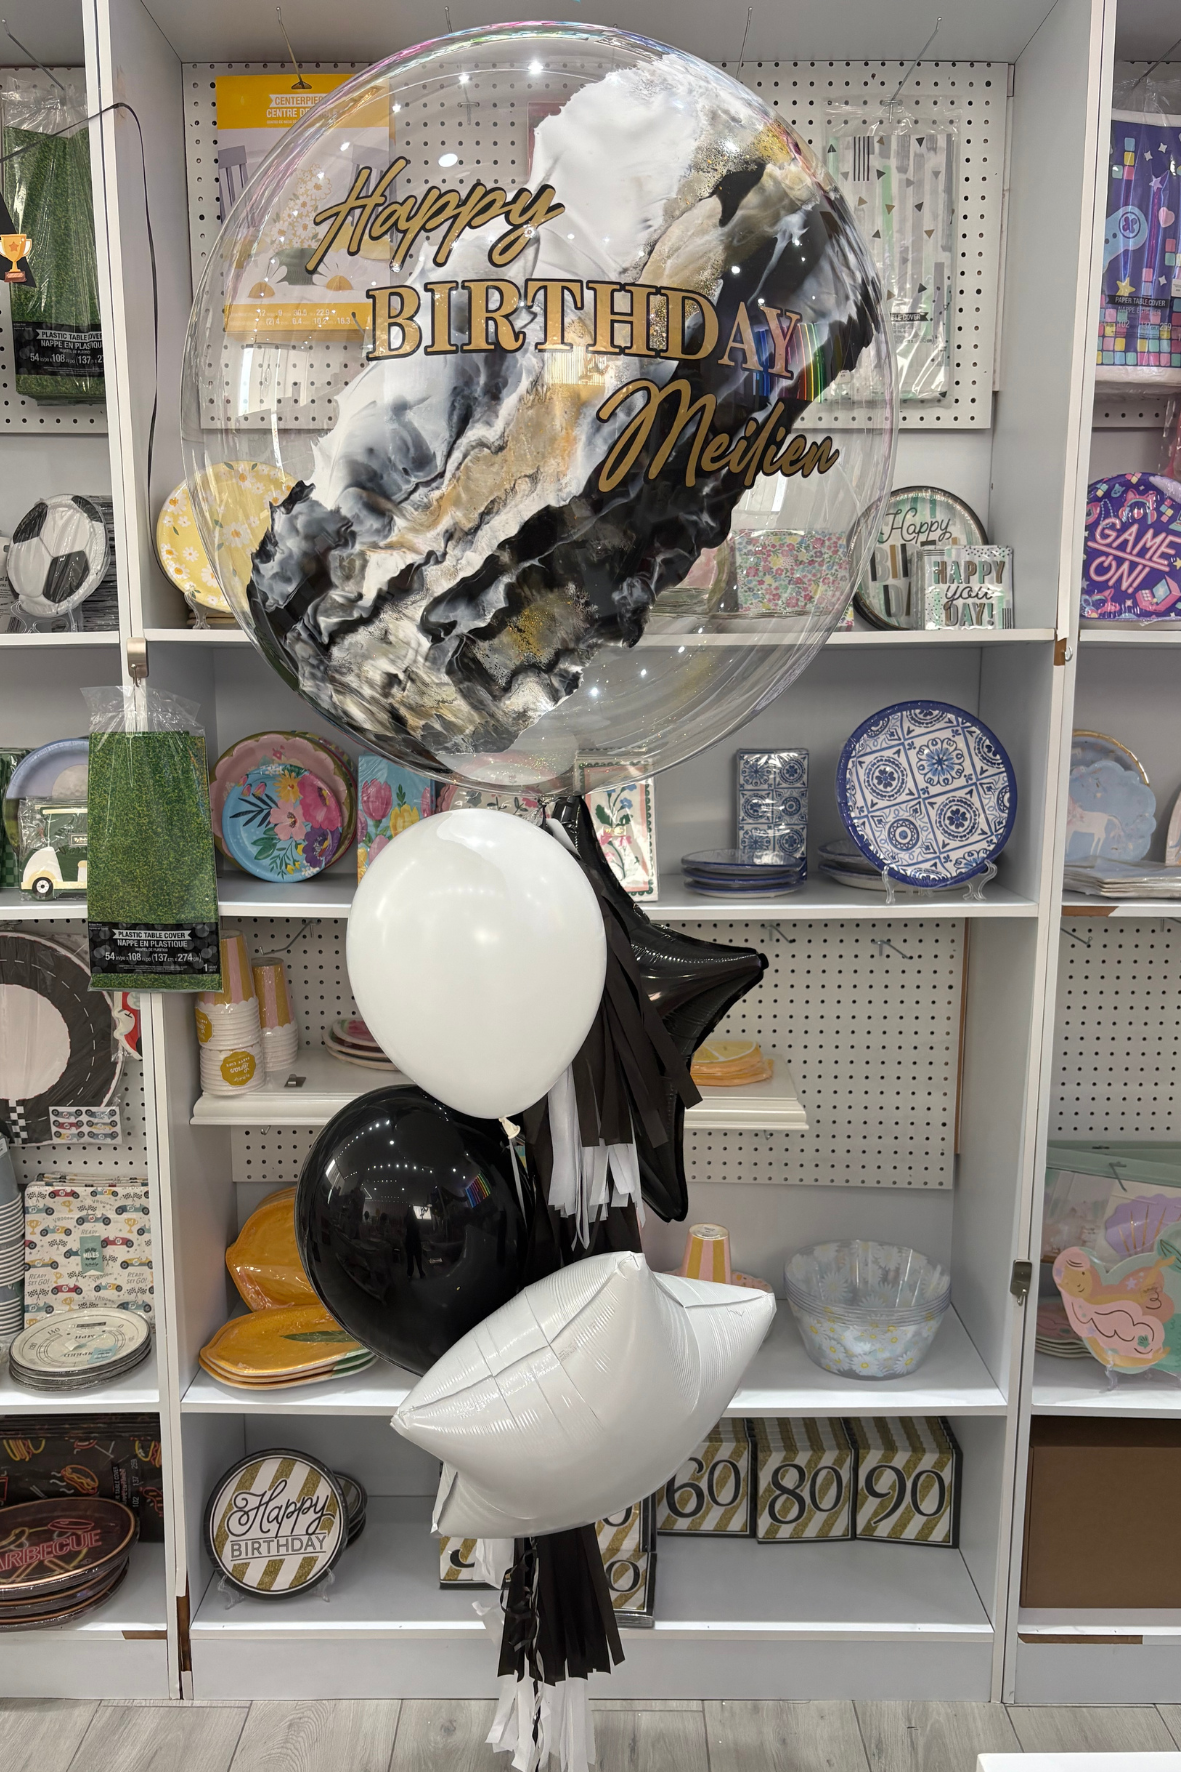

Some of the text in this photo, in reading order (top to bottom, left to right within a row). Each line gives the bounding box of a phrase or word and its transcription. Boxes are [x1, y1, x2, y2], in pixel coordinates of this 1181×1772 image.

[266, 108, 298, 118] CENTRE
[274, 96, 323, 105] CENTERPIE
[305, 156, 566, 274] Happy
[1115, 296, 1131, 304] PAPER
[1148, 299, 1166, 307] COVER
[41, 331, 67, 340] PLASTIC
[69, 333, 88, 341] TABLE
[365, 278, 803, 379] BIRTHDAY
[41, 339, 63, 348] NAPPE
[64, 341, 74, 349] EN
[30, 352, 40, 361] 54
[52, 353, 66, 362] 108
[596, 378, 840, 492] Meilien
[877, 507, 953, 545] Happy
[1094, 517, 1181, 566] GAME
[932, 560, 1006, 585] HAPPY
[1089, 555, 1150, 594] ON!
[944, 585, 993, 610] you
[944, 602, 995, 627] DAY!
[117, 939, 138, 947] NAPPE
[150, 940, 188, 948] PLASTIQUE
[143, 931, 163, 939] TABLE
[164, 931, 186, 939] COVER
[105, 952, 115, 961] 54
[128, 952, 141, 961] 108
[136, 1277, 148, 1285] GO!
[665, 1457, 741, 1518] 60
[768, 1463, 844, 1525] 80
[864, 1464, 946, 1526] 90
[226, 1479, 336, 1539] Happy
[0, 1529, 102, 1572] RBECUE
[230, 1535, 327, 1559] BIRTHDAY
[605, 1559, 641, 1593] 0
